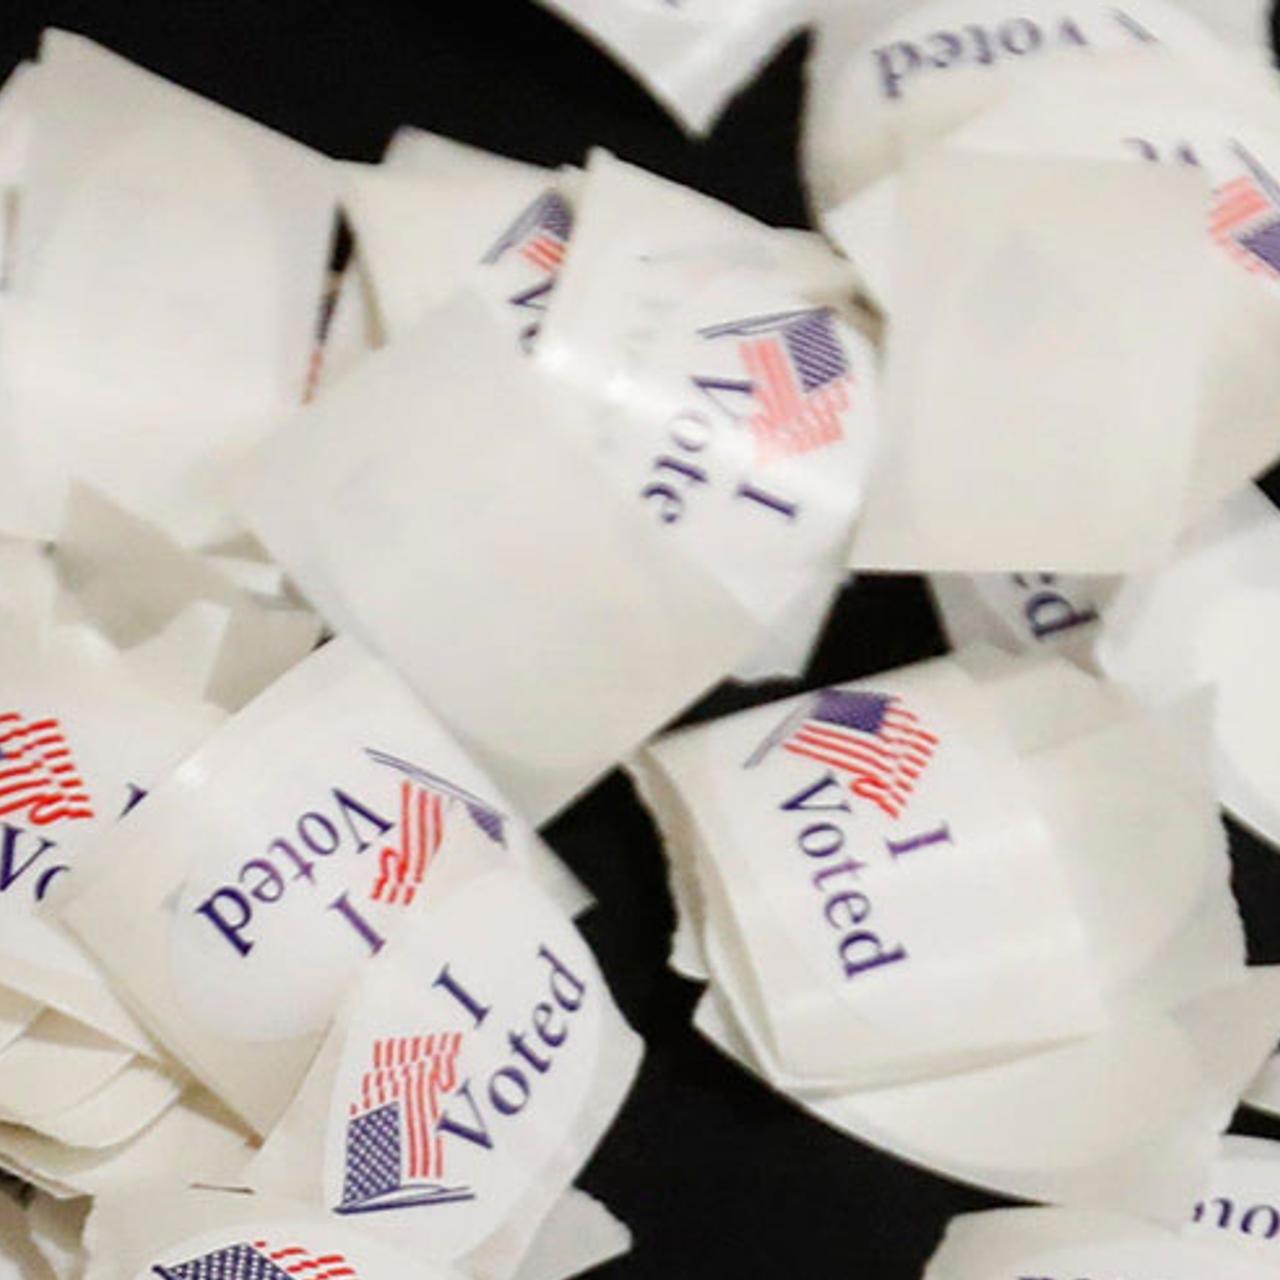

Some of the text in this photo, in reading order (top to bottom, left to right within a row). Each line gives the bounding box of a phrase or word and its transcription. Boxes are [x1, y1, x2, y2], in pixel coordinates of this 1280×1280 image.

[736, 482, 798, 519] I
[195, 785, 396, 958] Voted
[884, 820, 953, 859] I
[778, 774, 908, 980] Voted
[326, 891, 387, 957] I
[431, 963, 493, 1031] I
[436, 946, 588, 1156] Voted
